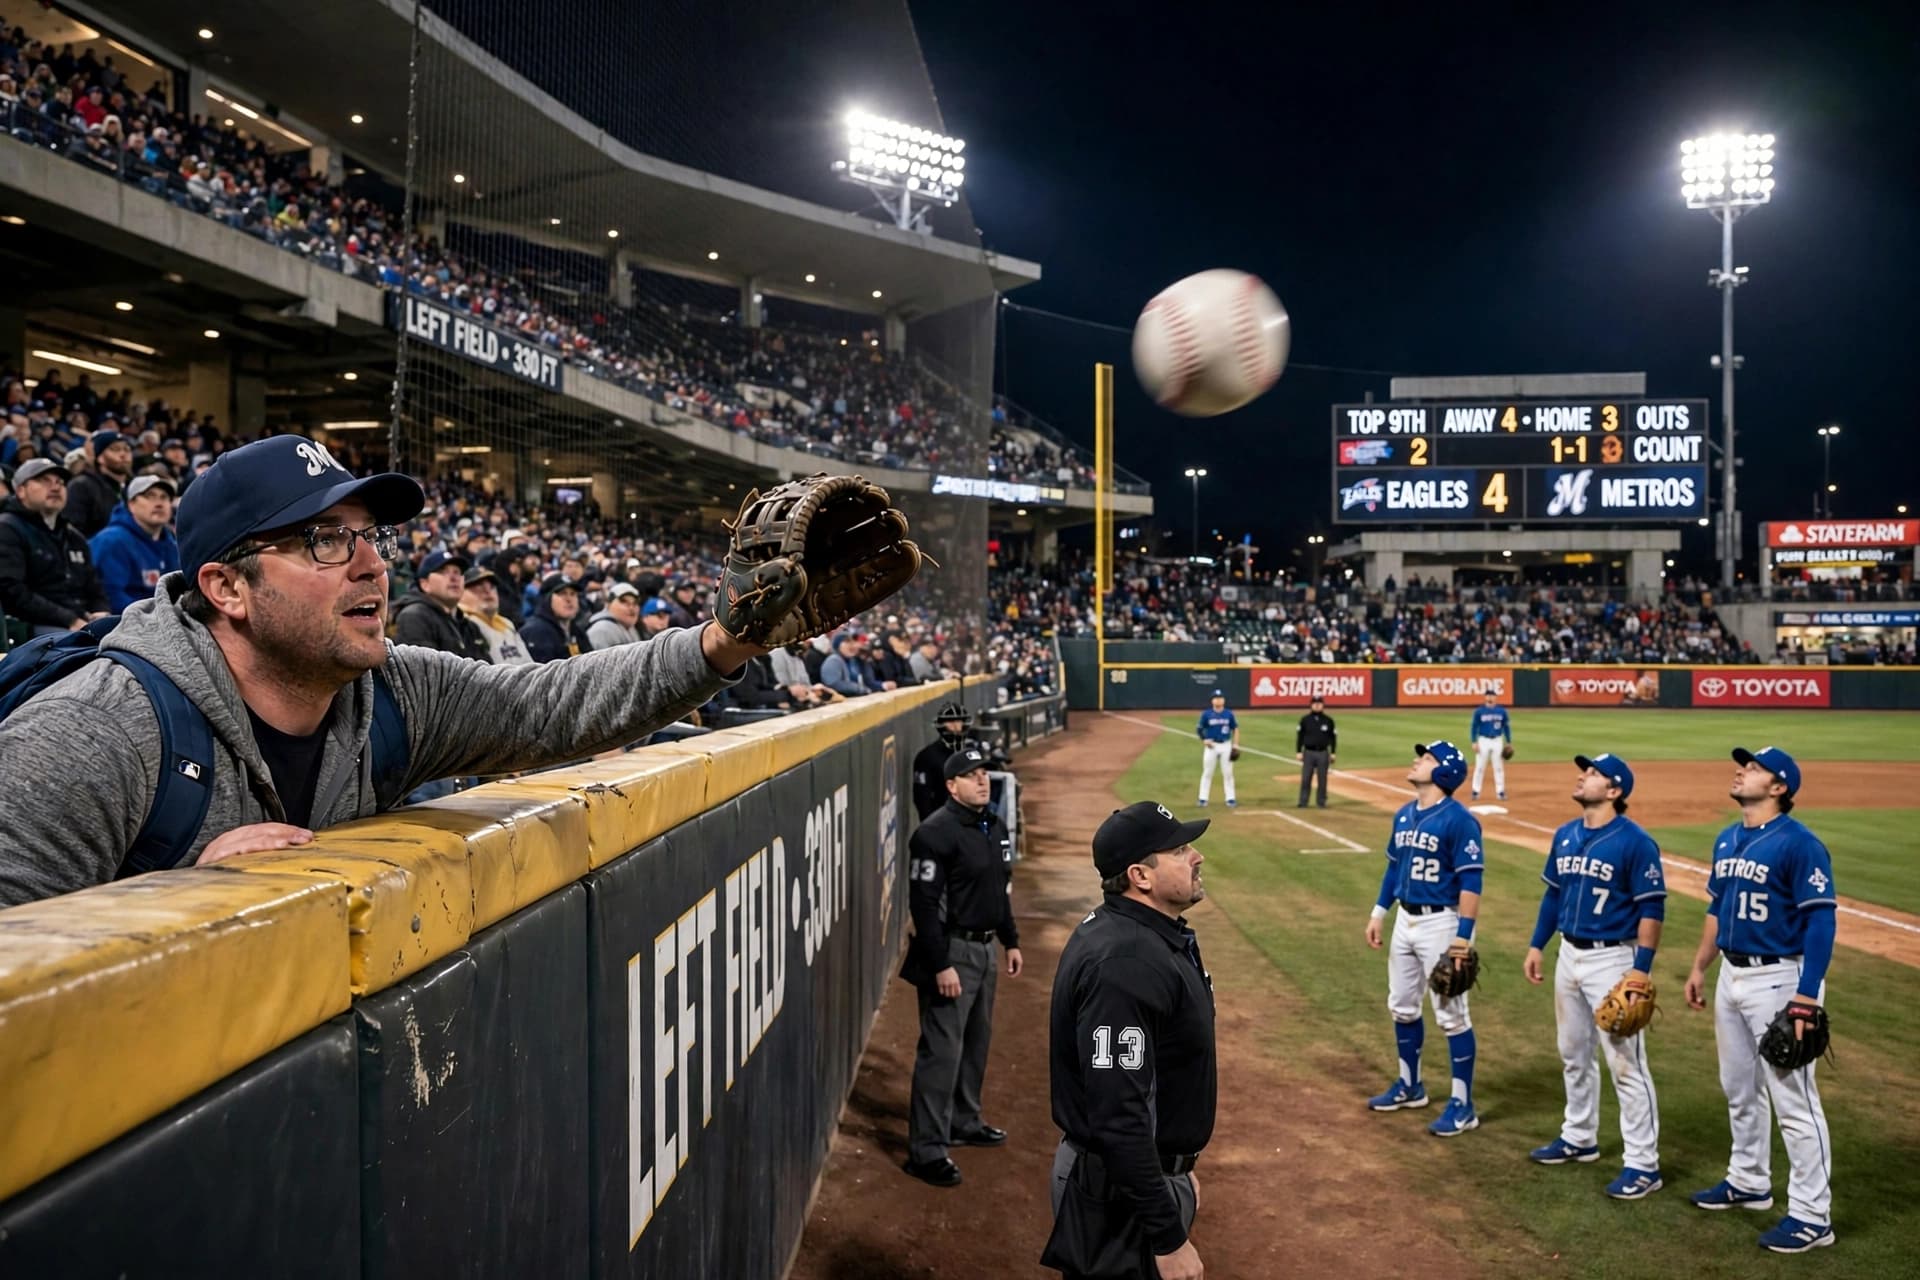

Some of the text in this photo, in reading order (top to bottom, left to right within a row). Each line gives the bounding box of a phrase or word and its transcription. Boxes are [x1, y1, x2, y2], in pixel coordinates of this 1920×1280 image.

[407, 298, 557, 387] LEFT FIELD 330 FT
[1347, 409, 1426, 434] TOP 9TH
[1443, 405, 1619, 433] AWAY 4 HOME 3
[1636, 405, 1689, 430] OUTS
[1410, 437, 1428, 465] 2
[1551, 436, 1587, 463] 1-1
[1634, 436, 1702, 462] COUNT
[1386, 473, 1509, 513] EAGLES 4
[1547, 469, 1594, 516] M
[1601, 477, 1695, 507] METROS
[1403, 678, 1504, 695] GATORADE
[1577, 679, 1637, 693] TOYOTA
[1732, 679, 1820, 696] TOYOTA
[1411, 856, 1440, 882] 22
[1592, 887, 1610, 915] 7
[1737, 891, 1769, 922] 15
[628, 784, 848, 1253] LEFT FIELD 330 FT
[1092, 1026, 1145, 1070] 13
